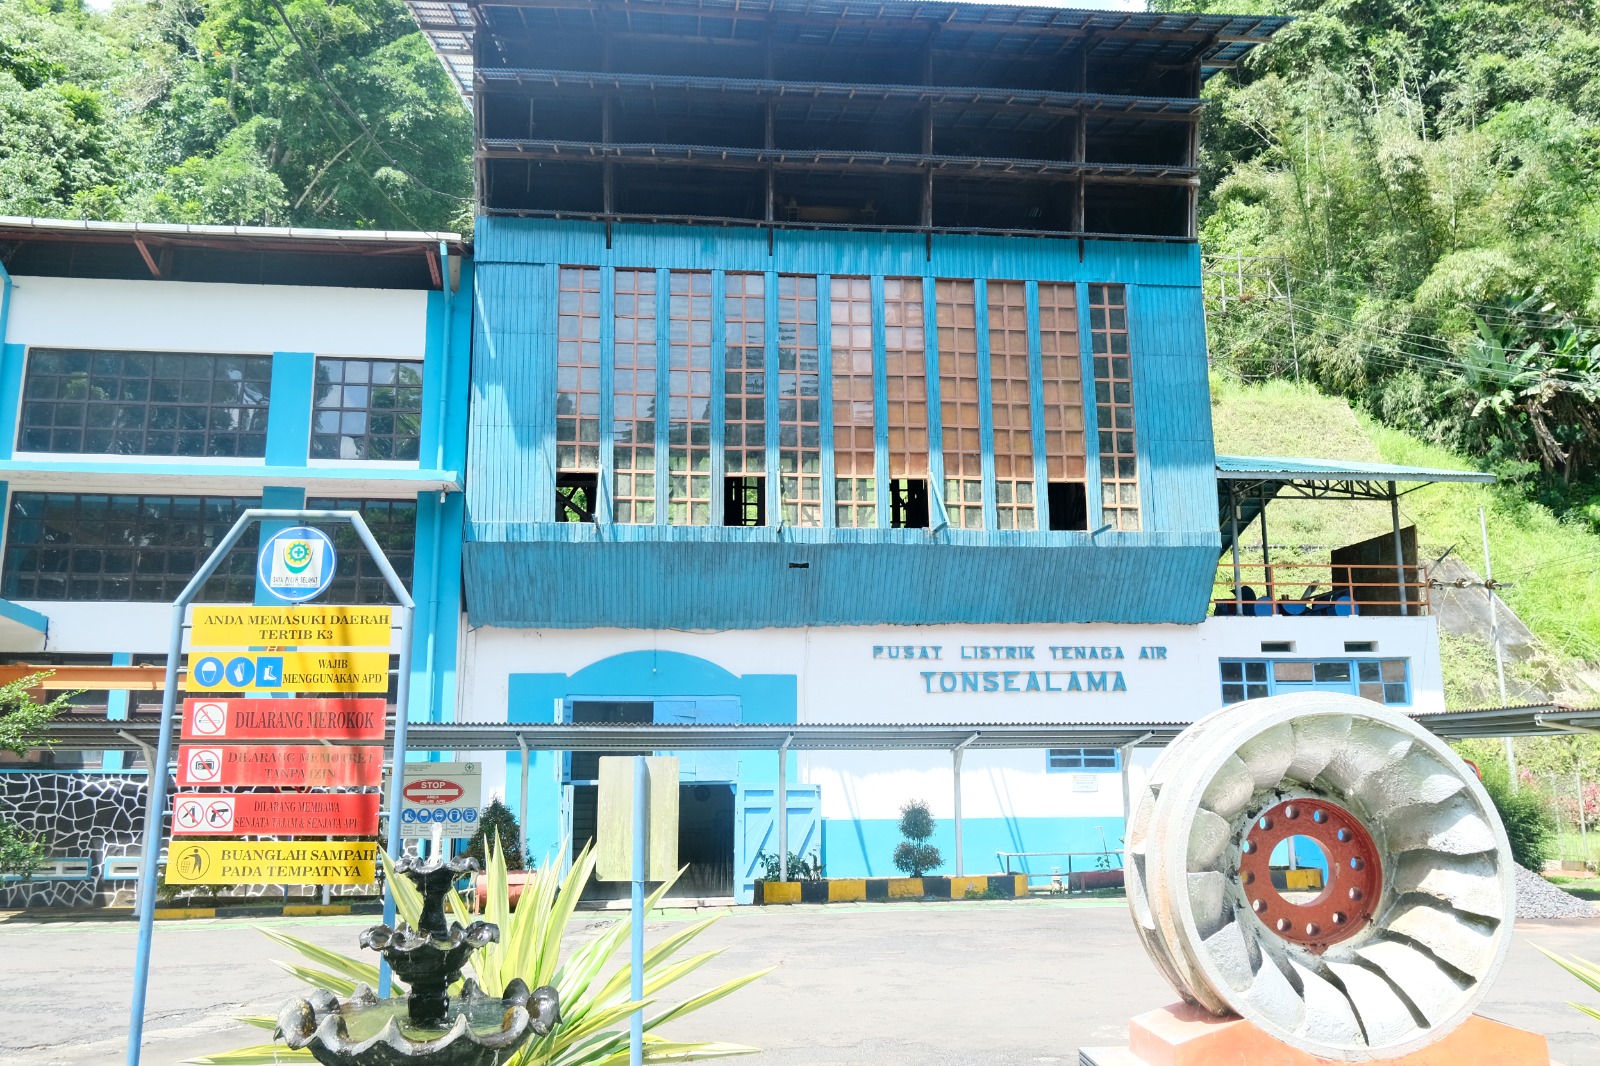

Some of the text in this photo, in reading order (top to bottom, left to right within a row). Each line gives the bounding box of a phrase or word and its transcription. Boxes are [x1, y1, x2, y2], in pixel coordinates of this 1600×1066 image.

[204, 614, 389, 625] ANDA MEMASUKI DAERAH
[259, 629, 333, 640] TERTIB K3
[872, 645, 1168, 660] PUSAT LISTRIK TENAGA AIR
[318, 659, 348, 669] WAJIB
[282, 673, 382, 684] MENGGUNAKAN APD
[919, 671, 1128, 693] TONSEALAMA
[235, 711, 375, 729] DILARANG MEROKOK
[228, 752, 374, 764] DILARANG MEMOTRET
[265, 768, 336, 779] TANPA IZIN
[421, 781, 446, 789] STOP
[254, 801, 340, 813] DILARANG MEMBAWA
[234, 817, 358, 829] SENJATA TAJAM & SENJATA API
[220, 849, 375, 861] BUANGLAH SAMPAH
[220, 865, 362, 877] PADA TEMPATNYA
